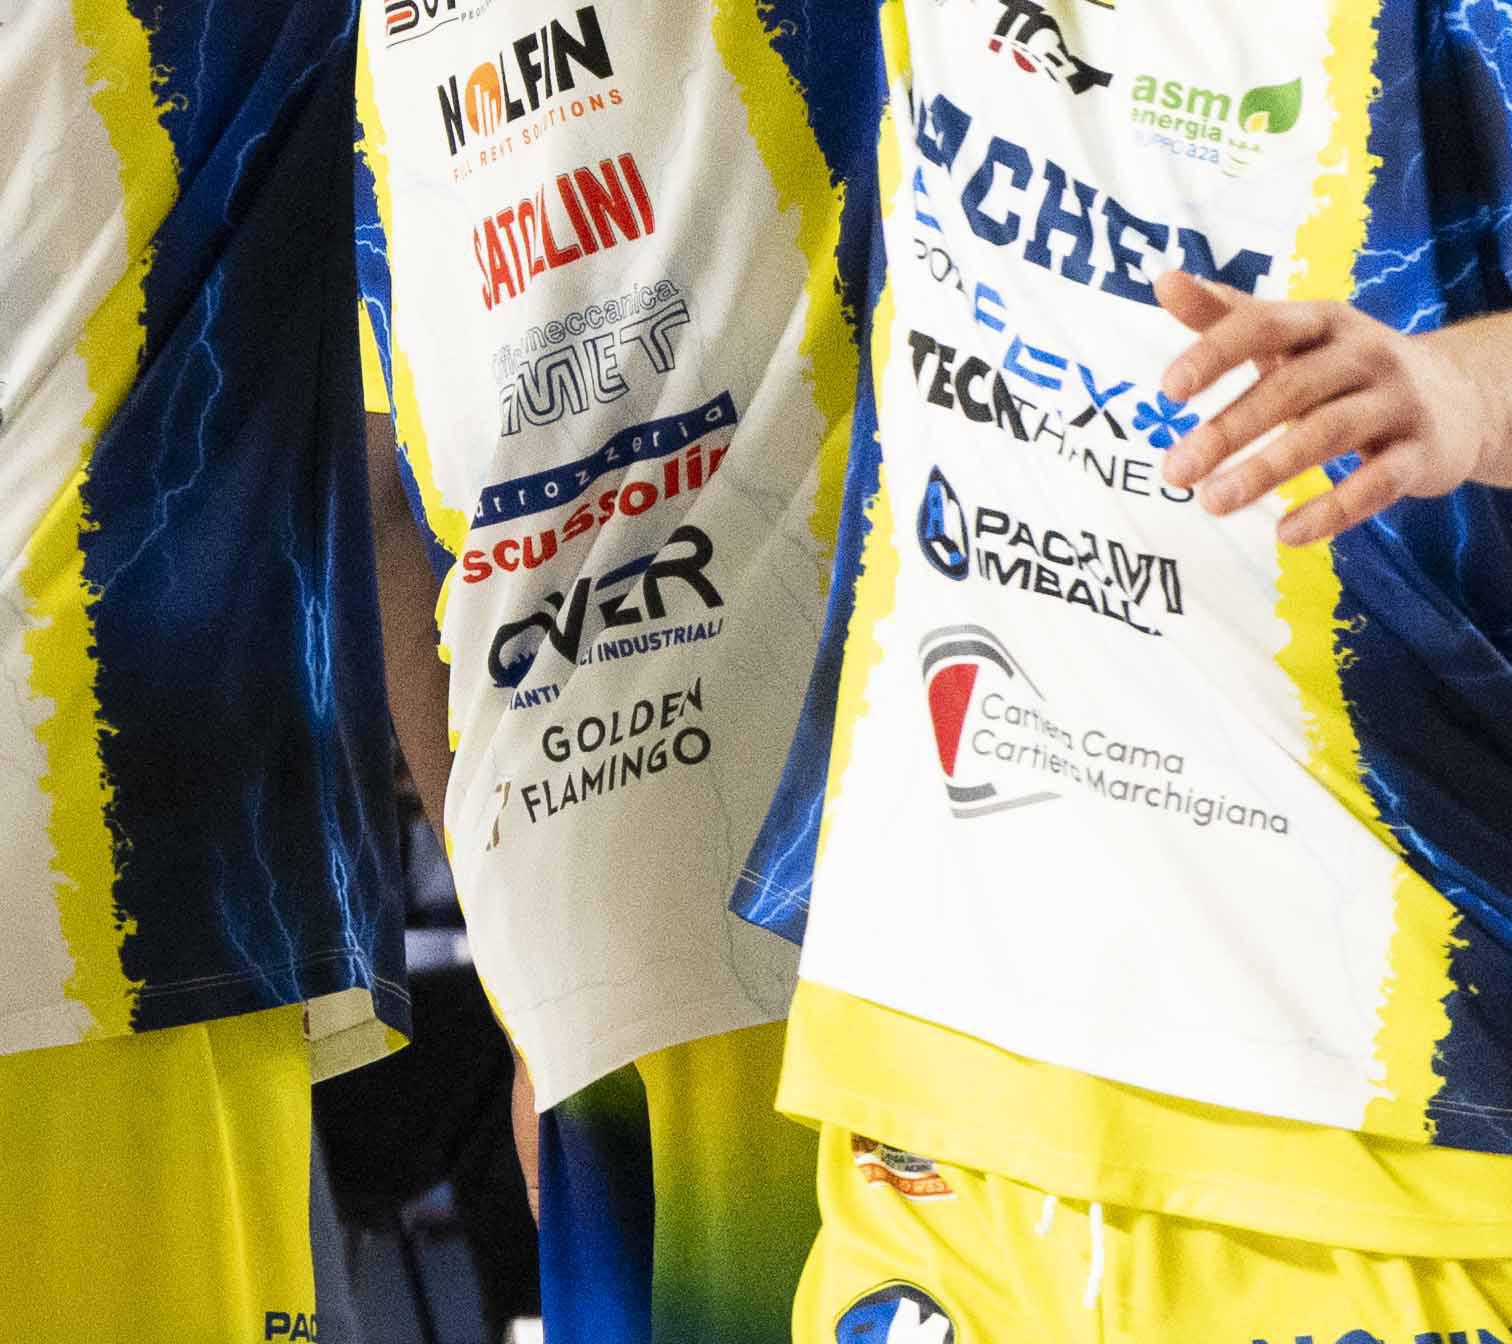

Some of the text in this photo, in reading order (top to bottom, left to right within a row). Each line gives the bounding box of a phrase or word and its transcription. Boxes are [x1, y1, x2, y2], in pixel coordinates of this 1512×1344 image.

[437, 5, 613, 156] NOLFIN
[1131, 71, 1232, 122] asm
[475, 405, 724, 520] arrozzeria
[542, 677, 703, 762] GOLDEN
[1082, 729, 1184, 775] Cama
[521, 727, 711, 823] FLAMINGO
